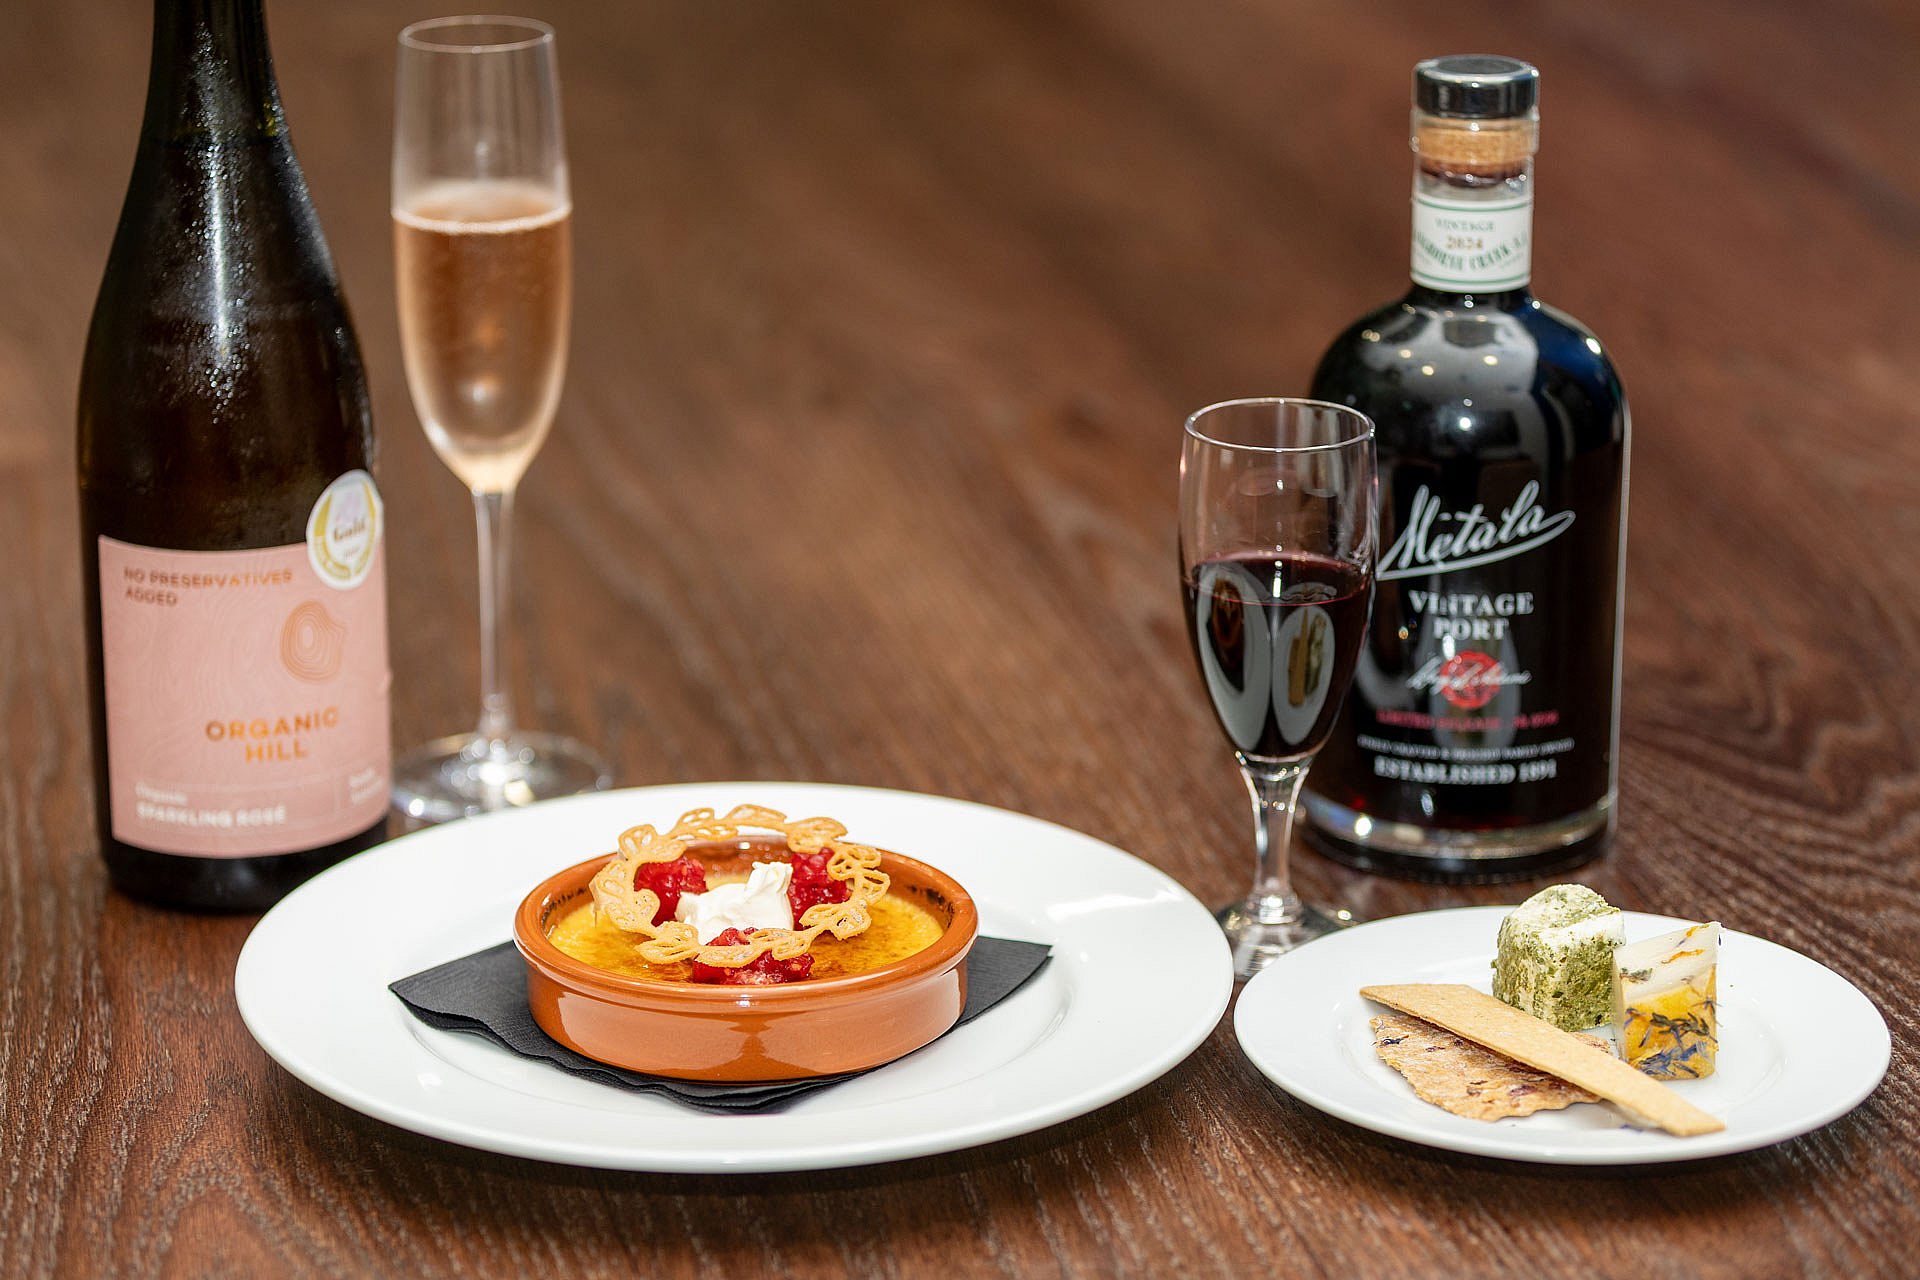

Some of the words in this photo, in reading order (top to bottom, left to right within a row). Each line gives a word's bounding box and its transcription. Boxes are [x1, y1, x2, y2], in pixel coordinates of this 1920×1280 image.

[1436, 218, 1494, 231] VINTAGE
[124, 567, 149, 583] NO
[152, 569, 292, 588] PRESERVATIVES
[125, 591, 178, 606] ADDED
[1408, 591, 1534, 615] VINTAGE
[1435, 618, 1509, 640] PORT
[205, 707, 339, 741] ORGANIC
[245, 740, 306, 763] HILL
[1374, 757, 1516, 784] ESTABLISHED
[136, 804, 233, 827] SPARKLING
